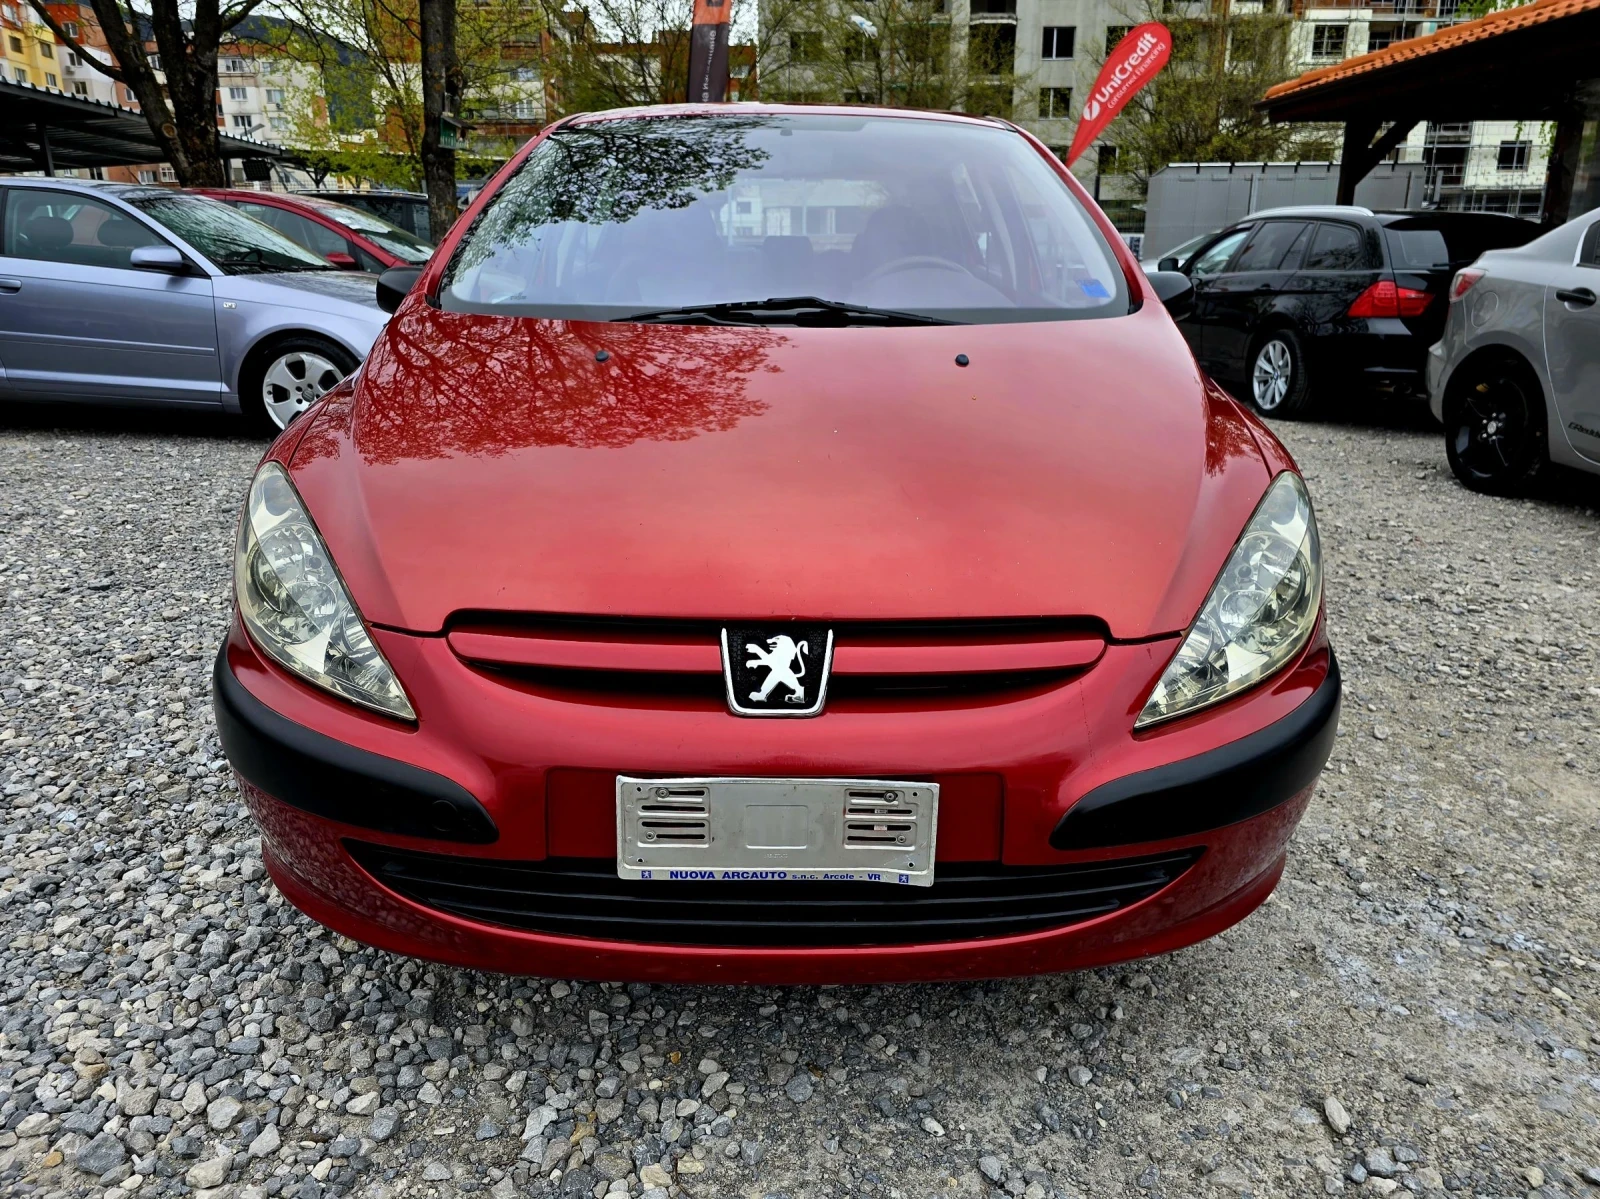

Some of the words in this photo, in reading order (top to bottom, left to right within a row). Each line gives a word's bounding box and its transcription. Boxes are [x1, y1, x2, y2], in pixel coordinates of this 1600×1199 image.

[1095, 32, 1157, 103] UniCredit
[1107, 75, 1137, 109] Consumer
[1134, 41, 1167, 76] Financing
[669, 870, 716, 880] NUOVA
[722, 871, 788, 880] ARCAUTO
[823, 872, 855, 880] Arcole
[867, 873, 881, 881] VR
